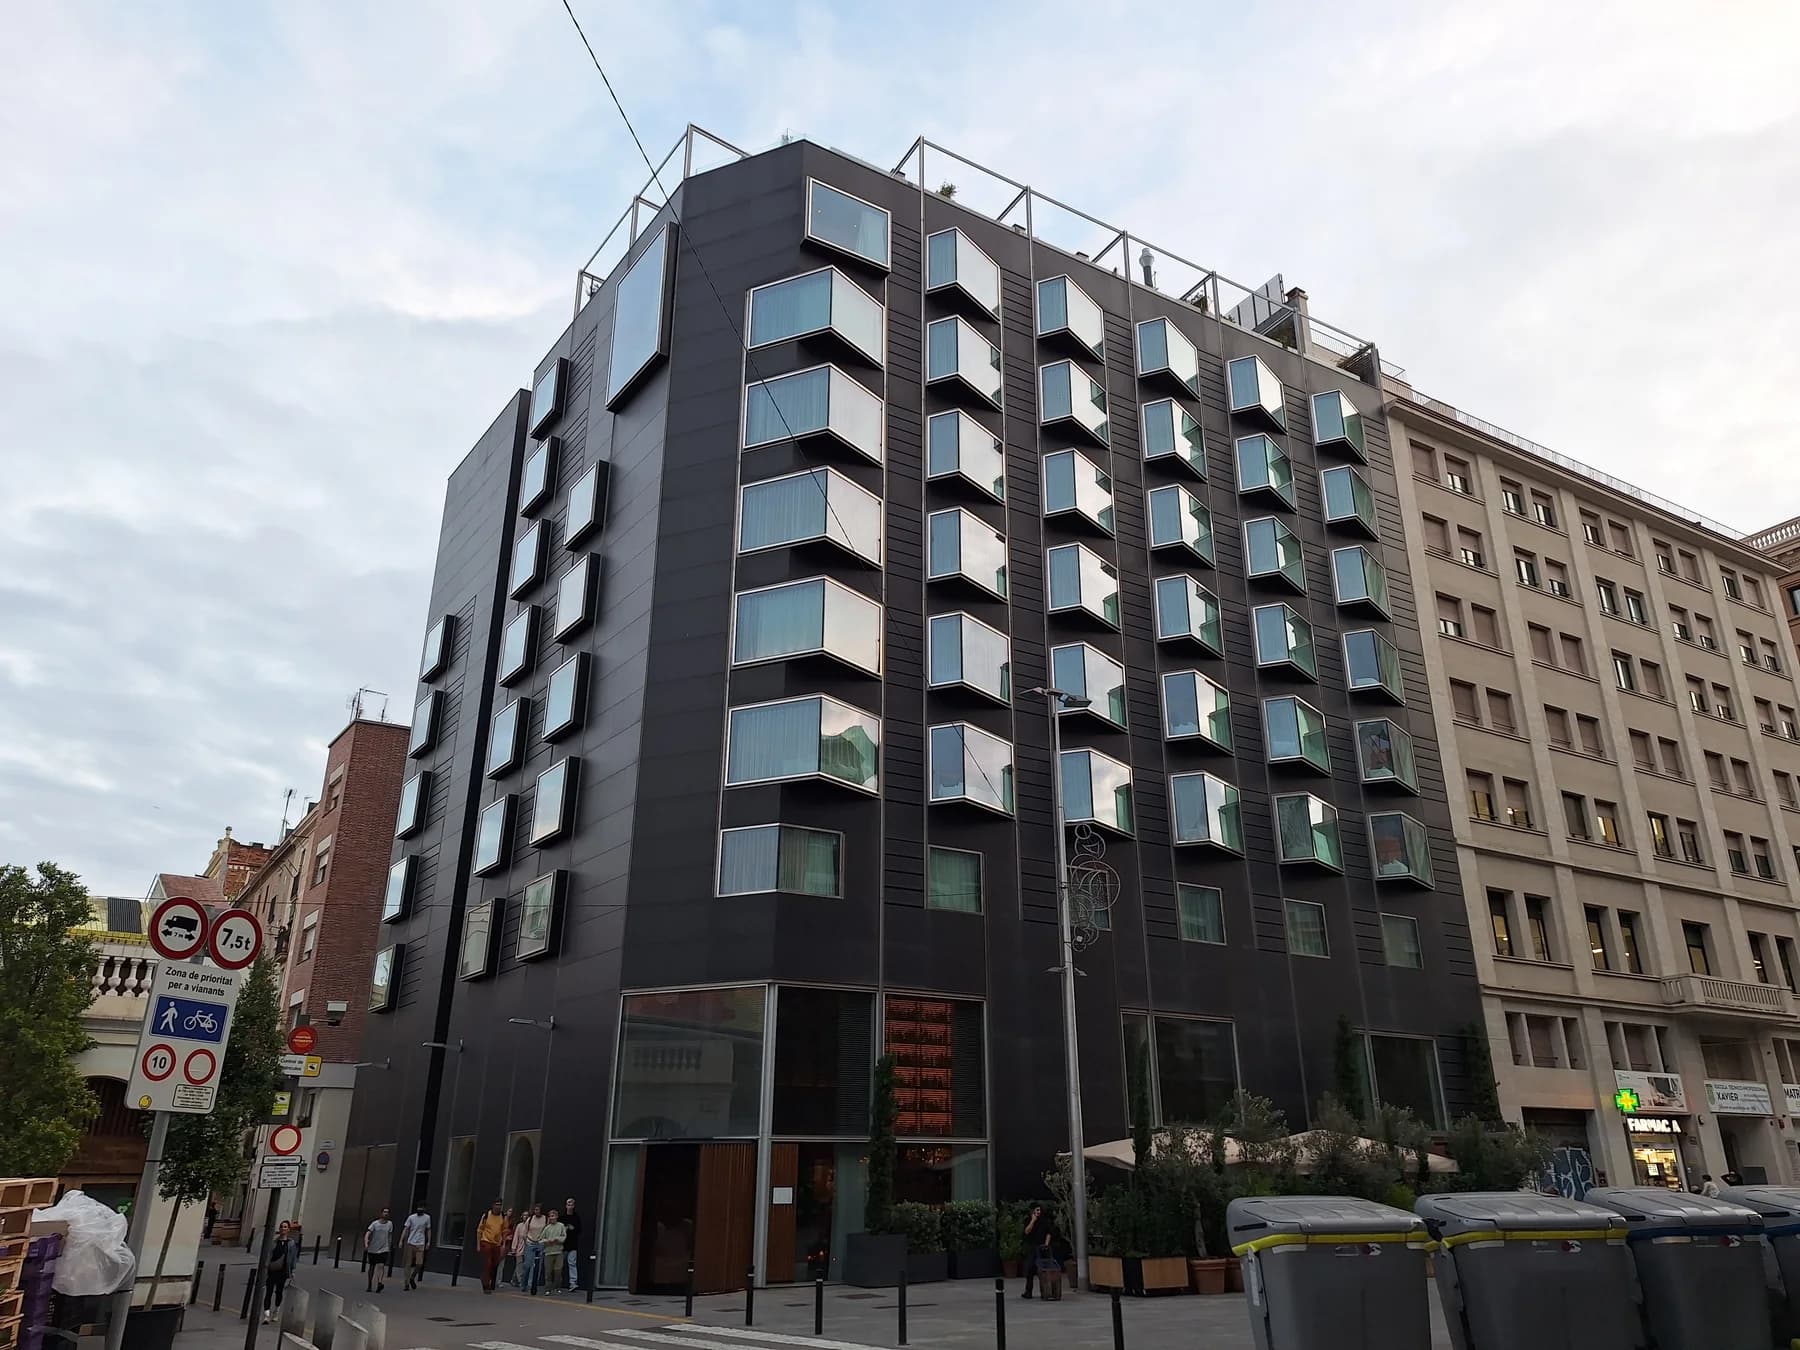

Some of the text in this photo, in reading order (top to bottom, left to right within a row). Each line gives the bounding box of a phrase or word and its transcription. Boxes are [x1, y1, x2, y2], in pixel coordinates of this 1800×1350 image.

[165, 966, 233, 986] Zona de prioritat
[167, 980, 225, 996] per a vianants
[151, 1055, 167, 1069] 10
[1716, 1091, 1739, 1101] XAVIER
[1626, 1117, 1681, 1133] FARMACA
